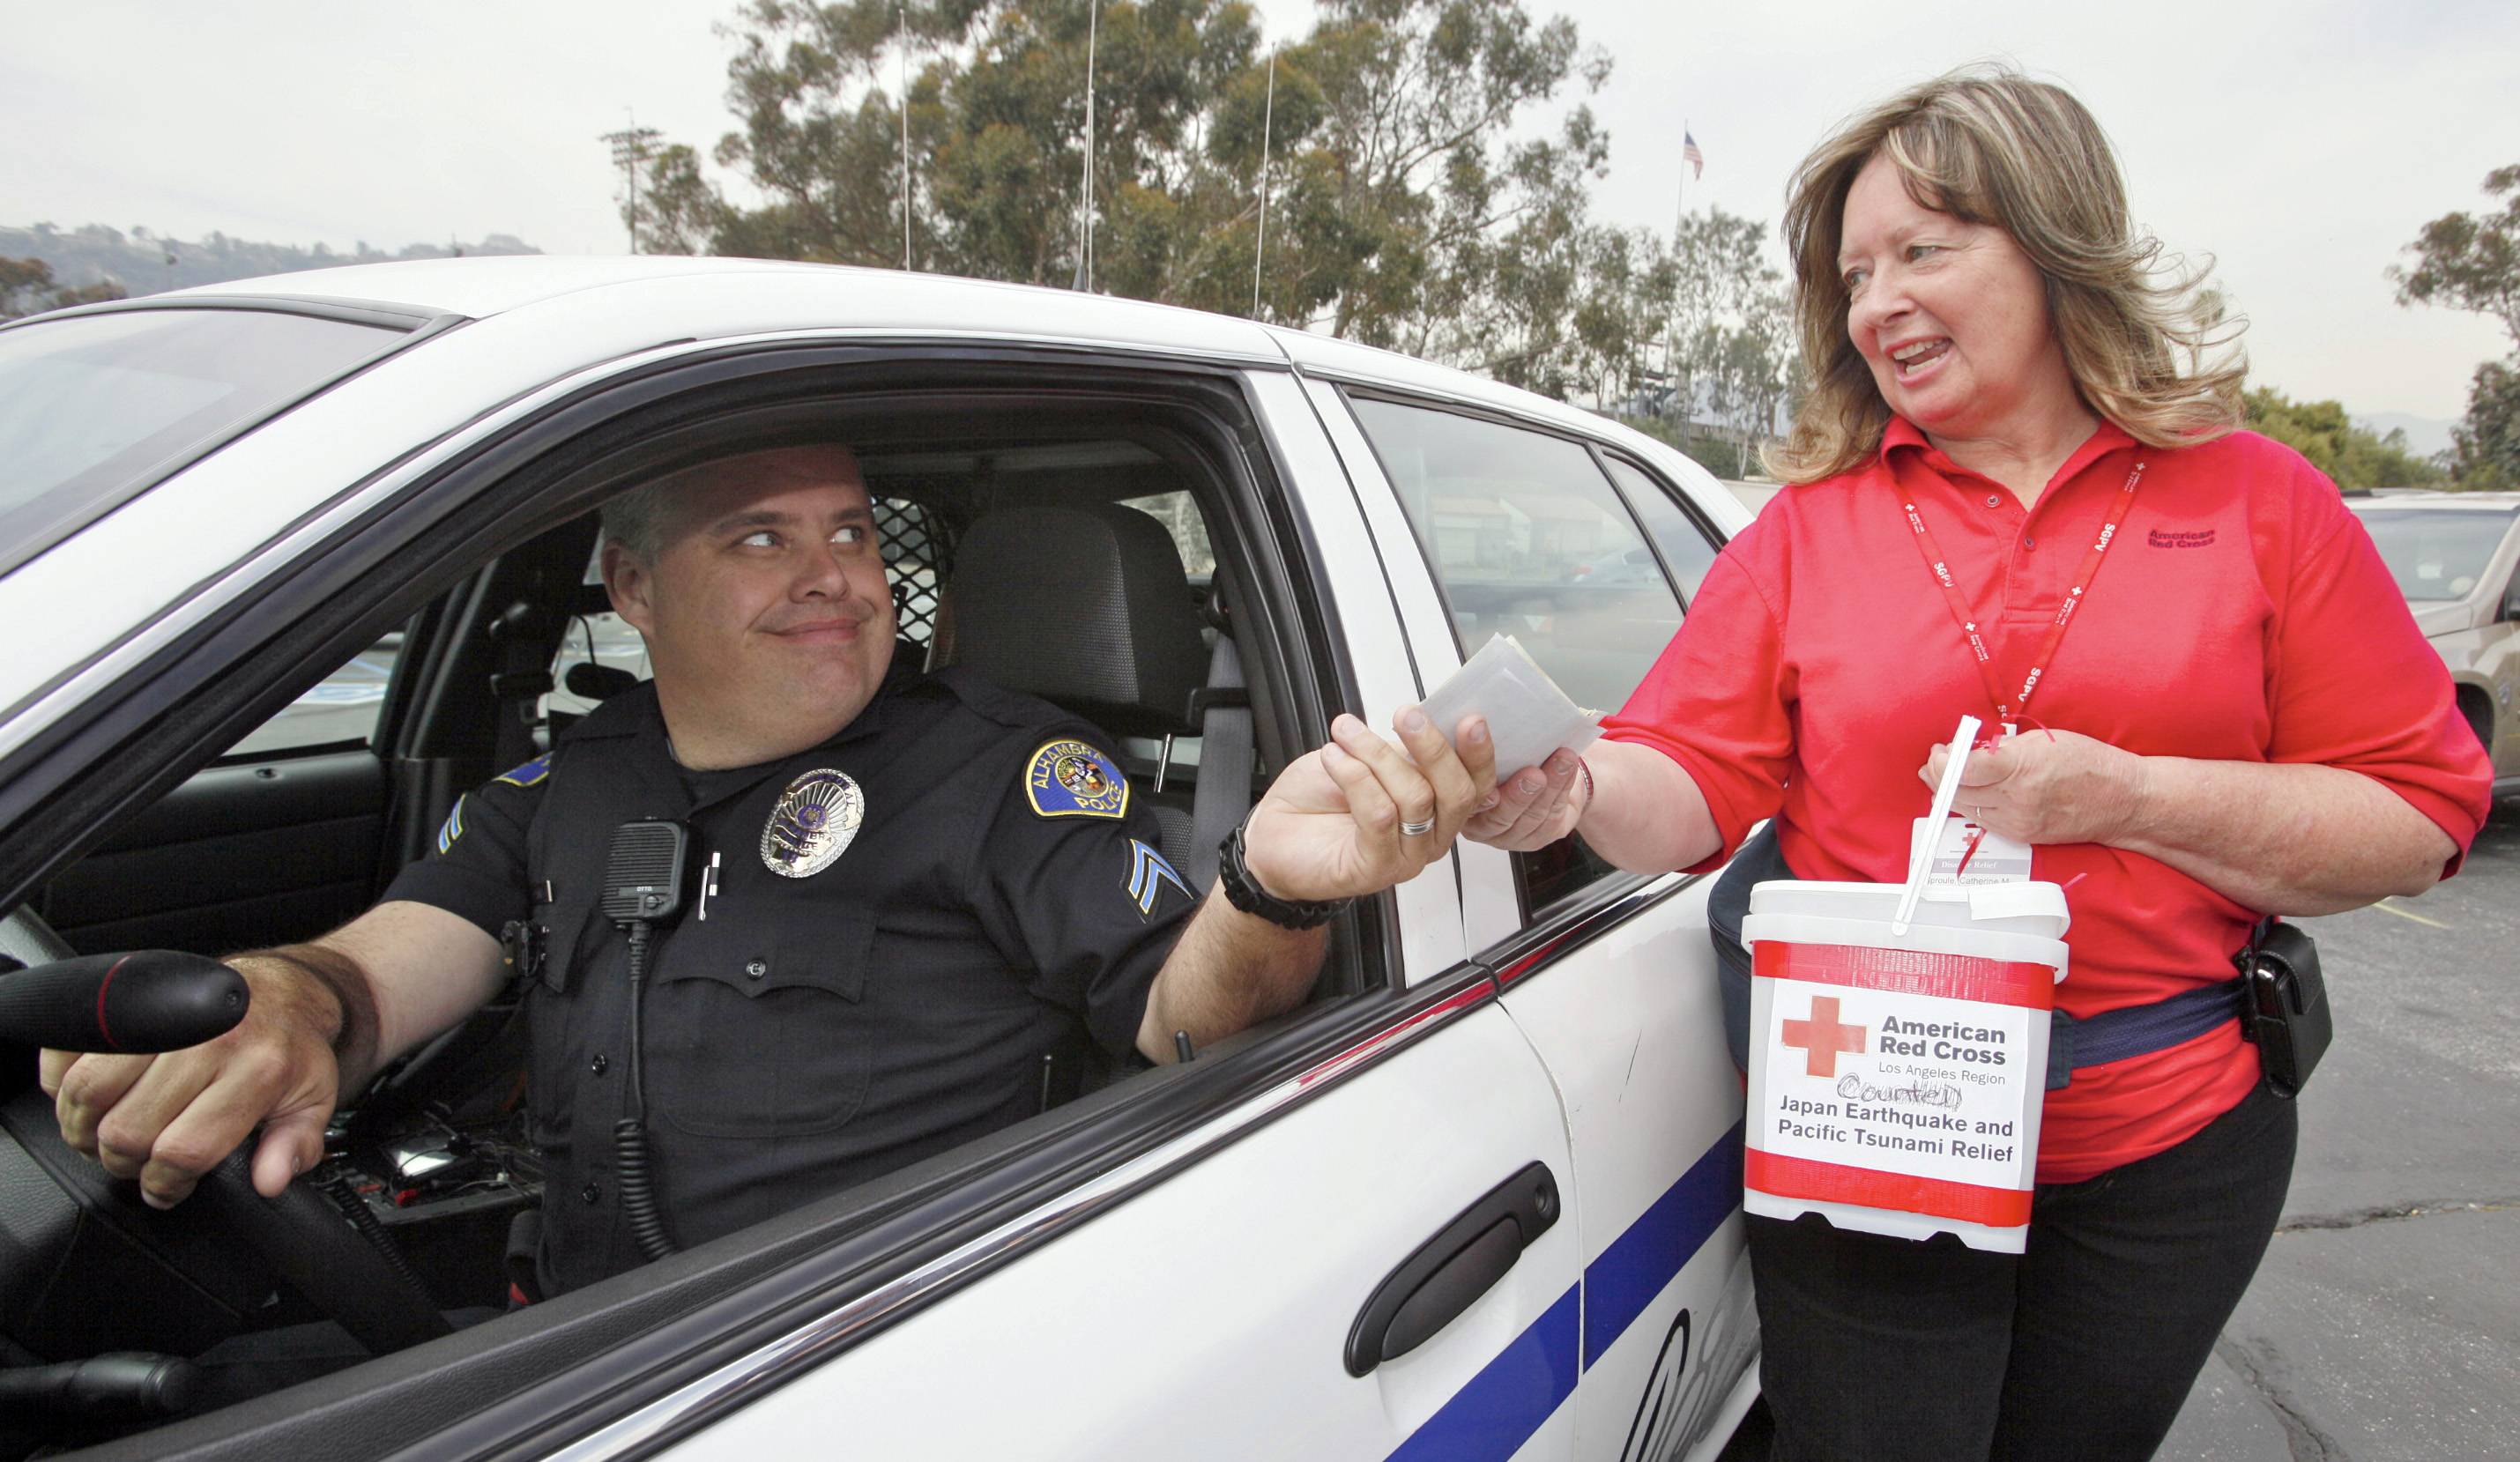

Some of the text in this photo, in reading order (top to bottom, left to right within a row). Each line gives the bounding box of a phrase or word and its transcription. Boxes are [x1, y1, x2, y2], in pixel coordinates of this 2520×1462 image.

[2094, 523, 2115, 552] SGPV
[2148, 537, 2215, 548] Red Cross
[2149, 530, 2216, 540] American
[1934, 562, 1954, 587] SGPV
[2018, 667, 2041, 702] SGPV
[1033, 743, 1104, 790] ALHAMBRA
[1074, 780, 1122, 811] POLICE
[1881, 1015, 2006, 1044] American
[1880, 1035, 2007, 1065] Red Cross
[1878, 1061, 2006, 1086] Los Angeles Region
[1780, 1095, 2013, 1137] Japan Earthquake and
[1779, 1118, 2013, 1162] Pacific Tsunami Relief
